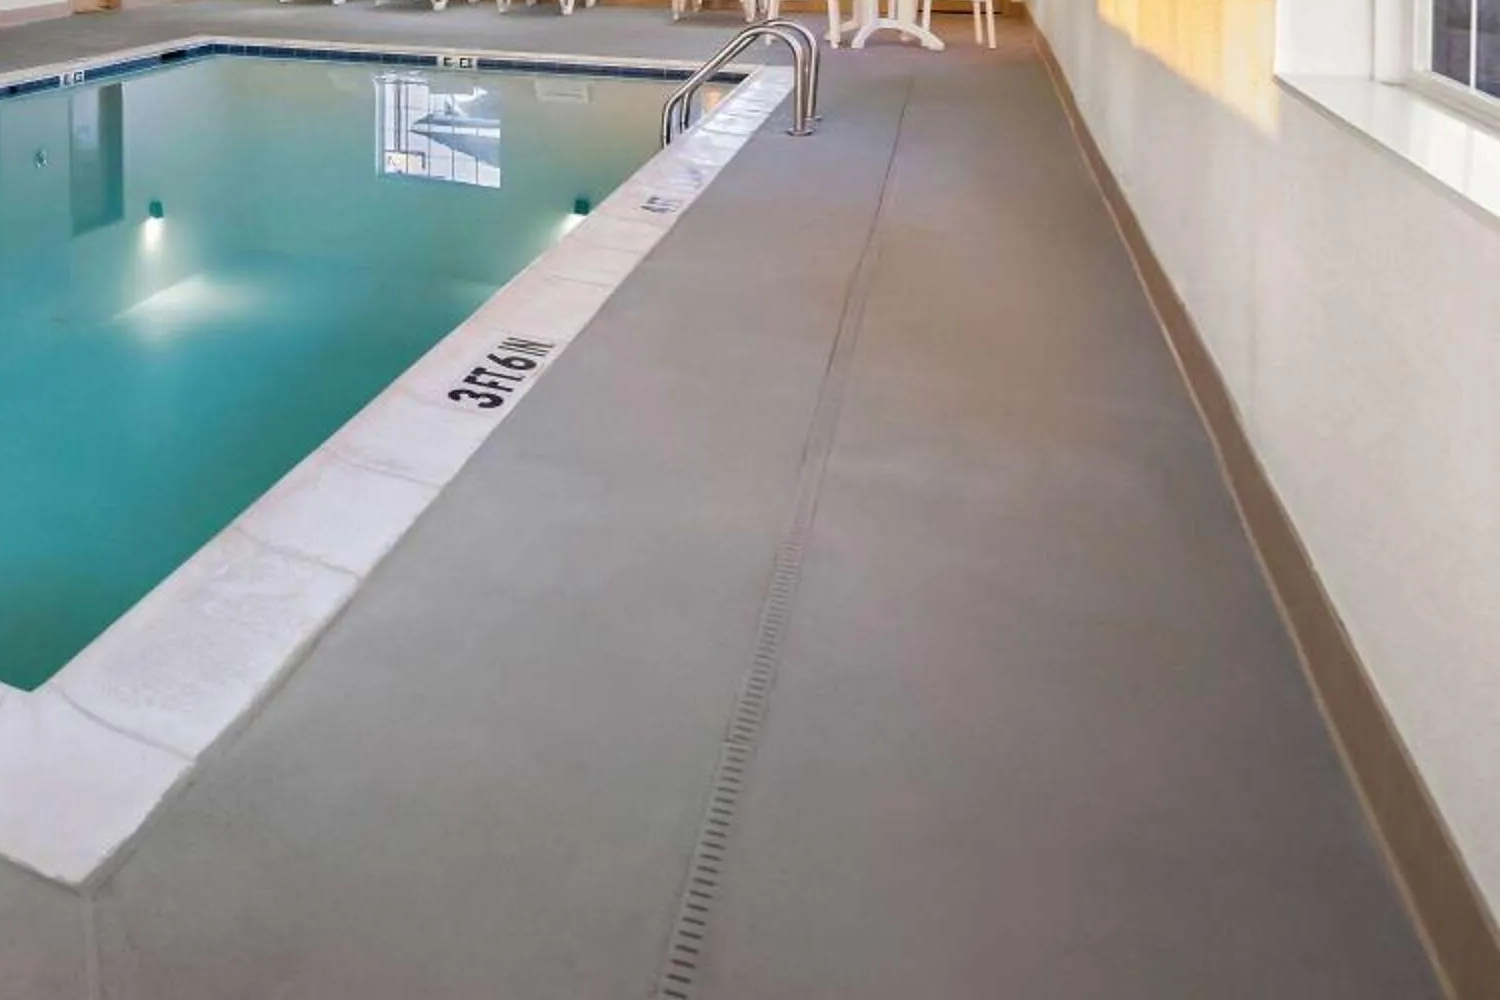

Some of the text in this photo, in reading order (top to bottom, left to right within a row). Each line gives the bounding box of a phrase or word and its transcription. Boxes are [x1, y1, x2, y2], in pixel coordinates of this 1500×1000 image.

[447, 336, 557, 409] 3 FT 6 IN
